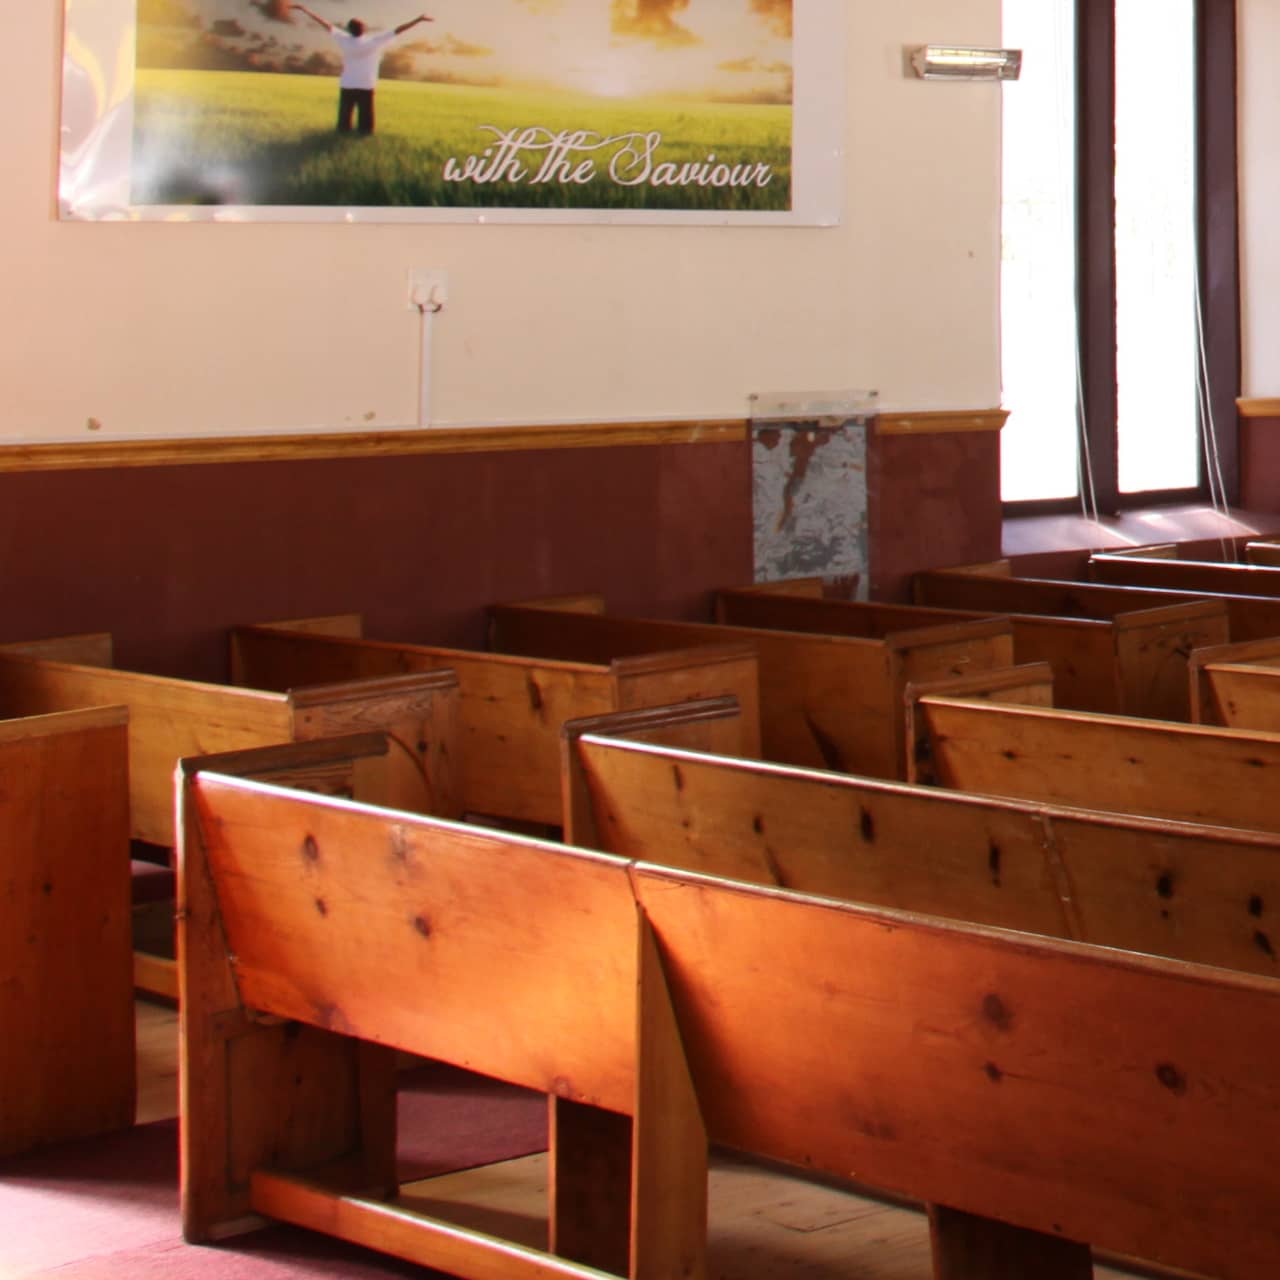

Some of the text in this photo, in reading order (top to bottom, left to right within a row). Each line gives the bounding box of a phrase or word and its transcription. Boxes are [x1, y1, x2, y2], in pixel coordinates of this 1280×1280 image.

[443, 125, 773, 187] with the Saviour
